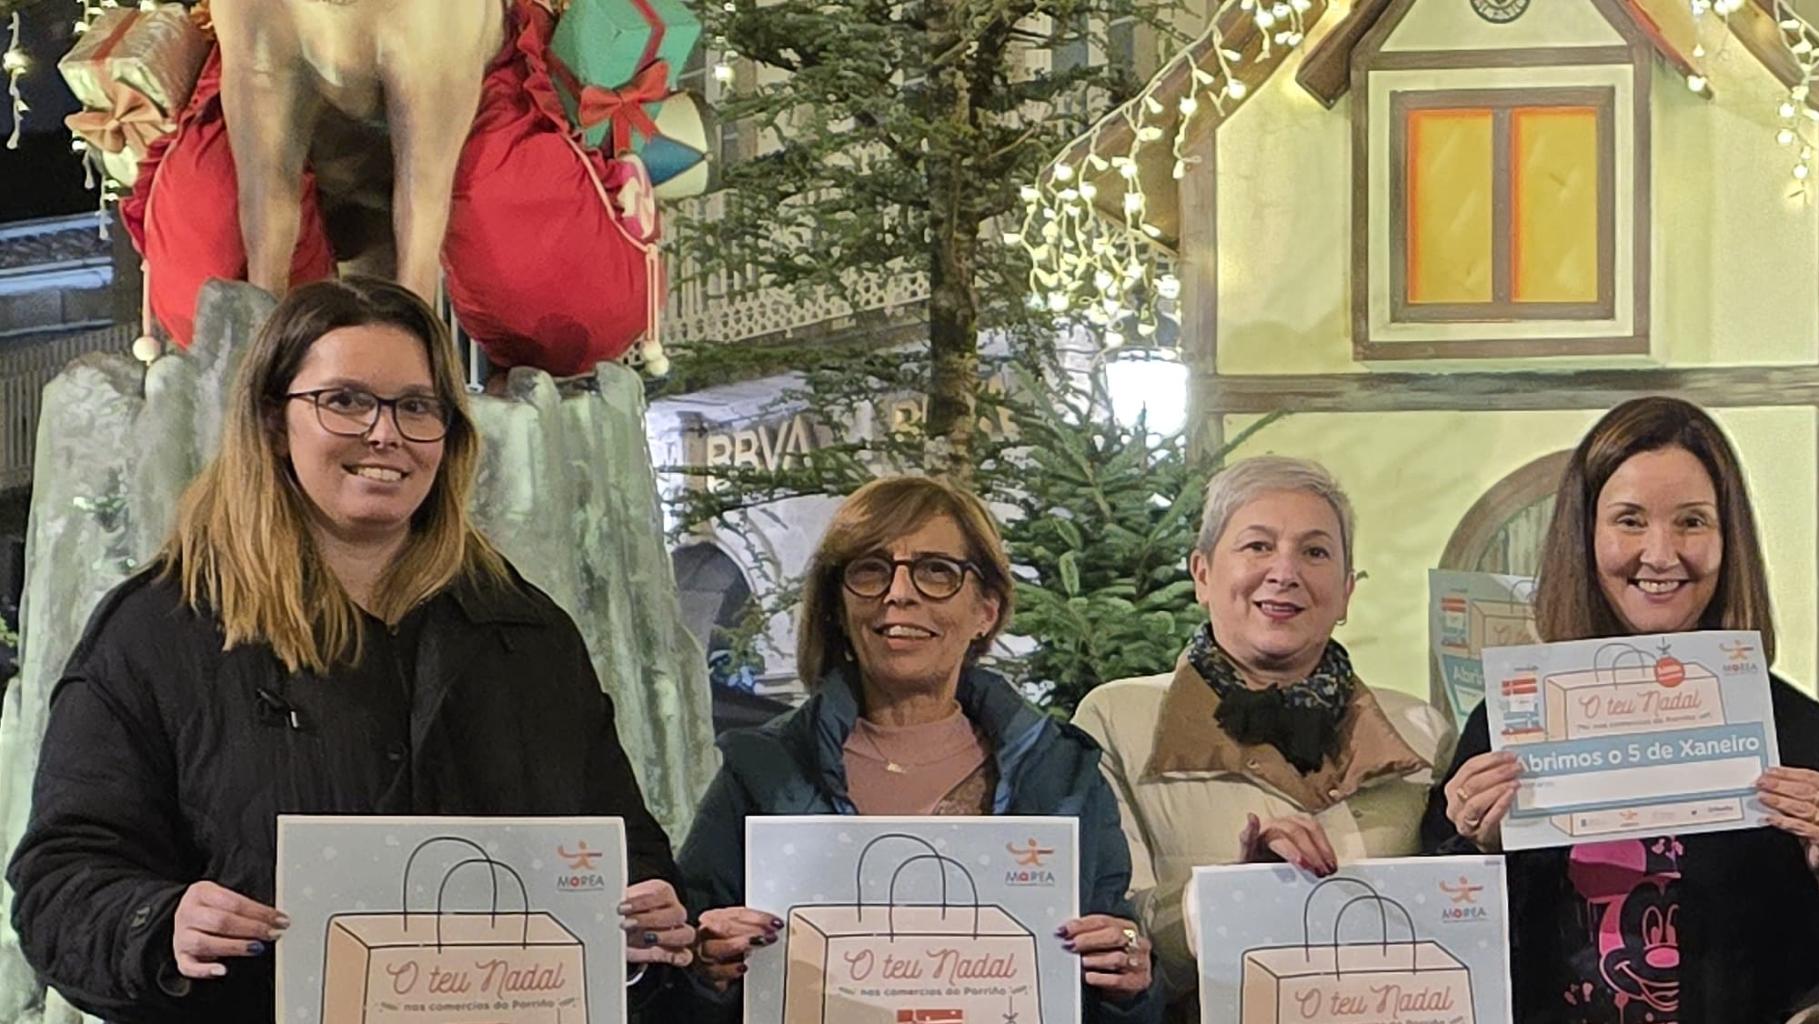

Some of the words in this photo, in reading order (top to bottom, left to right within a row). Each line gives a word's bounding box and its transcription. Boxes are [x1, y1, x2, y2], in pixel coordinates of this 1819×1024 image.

[707, 415, 813, 493] BBVA
[1579, 695, 1600, 718] O
[1608, 697, 1634, 715] teu
[1637, 689, 1702, 716] Nadal
[1517, 749, 1602, 773] Abrimos
[1608, 751, 1622, 763] o
[1628, 744, 1640, 761] 5
[1647, 742, 1673, 759] de
[1680, 735, 1759, 757] Xaneiro
[557, 875, 605, 889] MOREA
[1005, 871, 1054, 883] MOREA
[386, 961, 419, 994] O
[428, 966, 471, 994] teu
[475, 959, 565, 1000] Nadal
[844, 949, 874, 981] O
[882, 953, 923, 979] teu
[926, 948, 1017, 985] Nadal
[1295, 988, 1322, 1019] O
[1330, 992, 1367, 1014] teu
[1370, 984, 1454, 1019] Nadal
